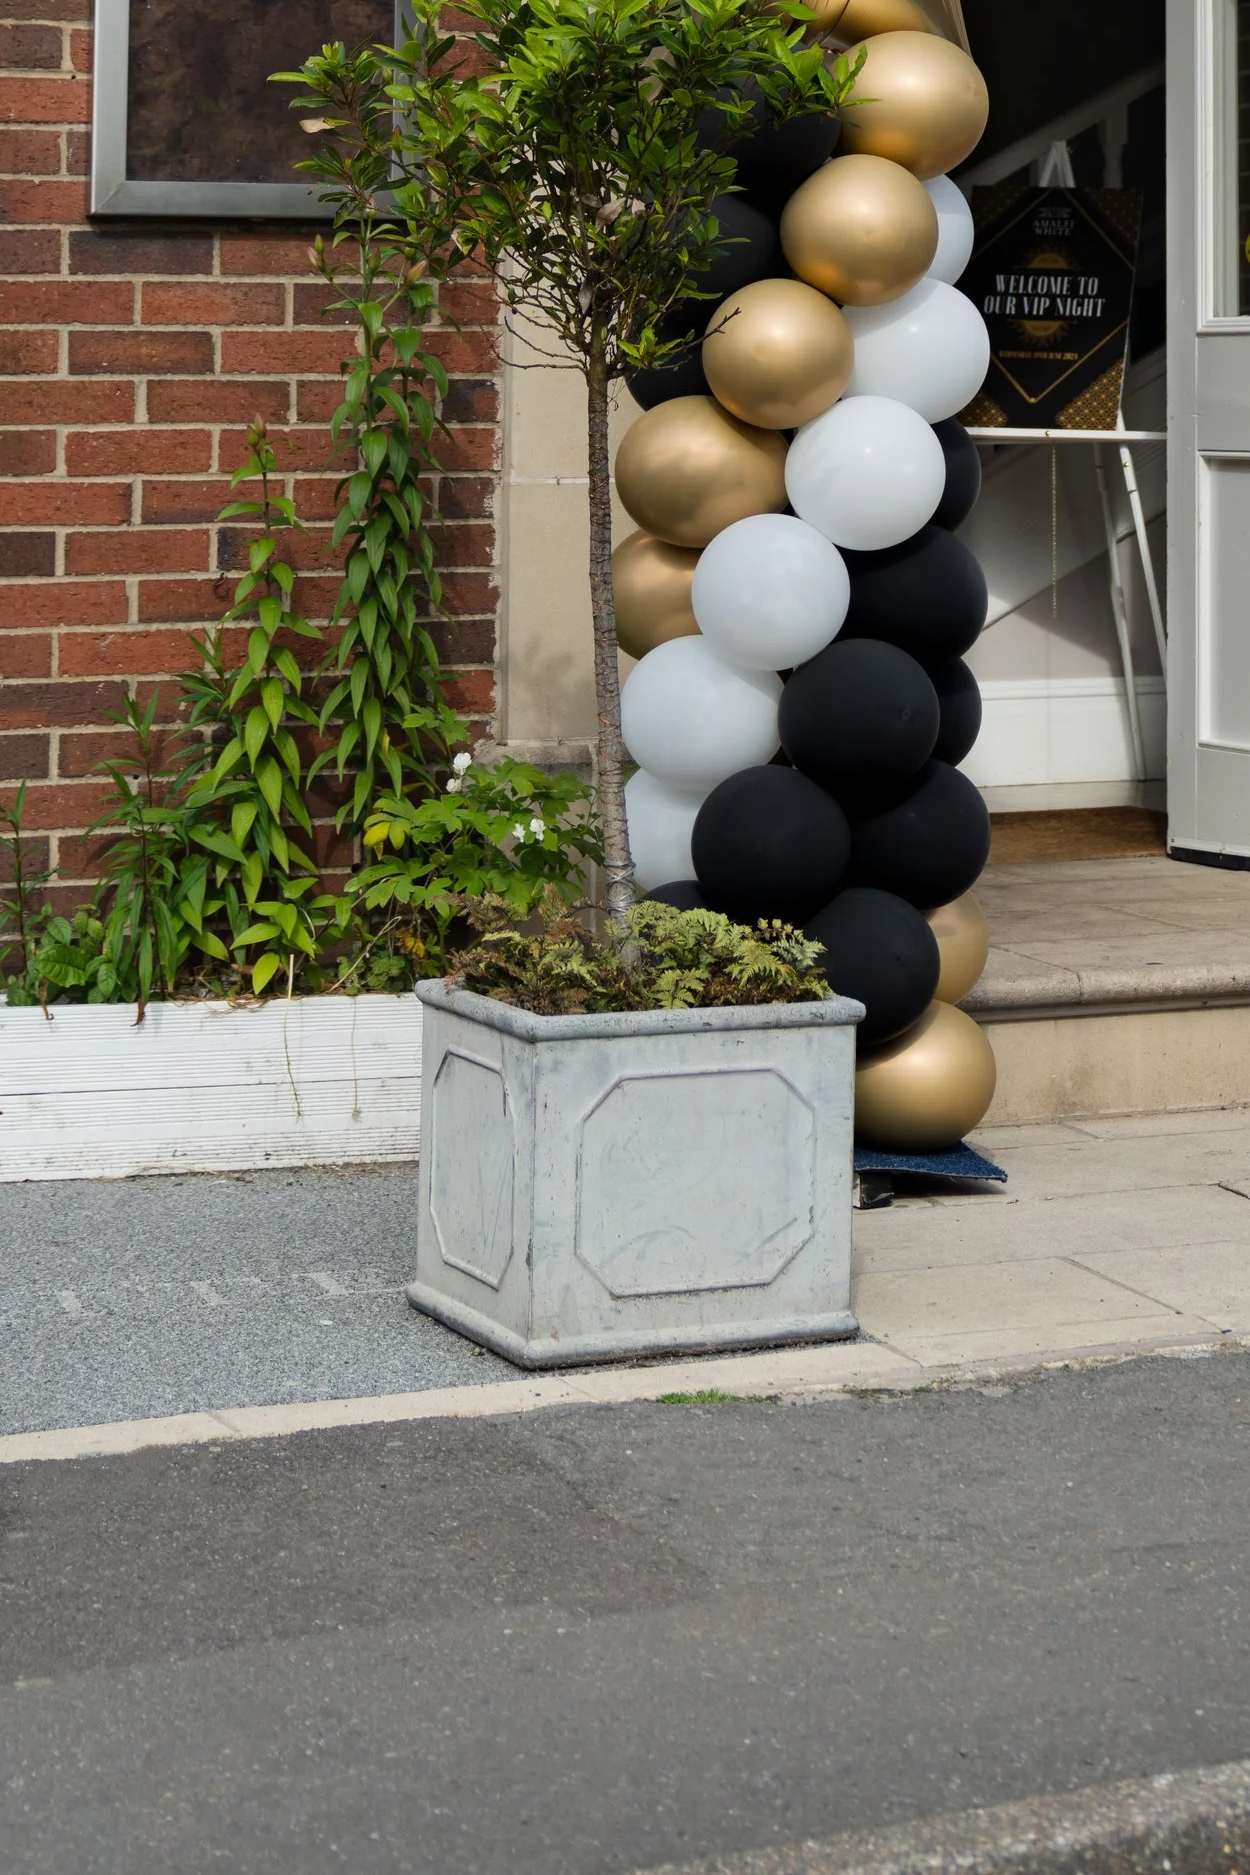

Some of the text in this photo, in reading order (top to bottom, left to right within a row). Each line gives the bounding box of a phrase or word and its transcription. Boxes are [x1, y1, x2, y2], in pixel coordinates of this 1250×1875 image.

[1032, 219, 1075, 228] AMALFI
[1034, 227, 1073, 237] WHITE
[995, 274, 1099, 296] WELCOME TO
[983, 295, 1106, 317] OUR VIP NIGHT
